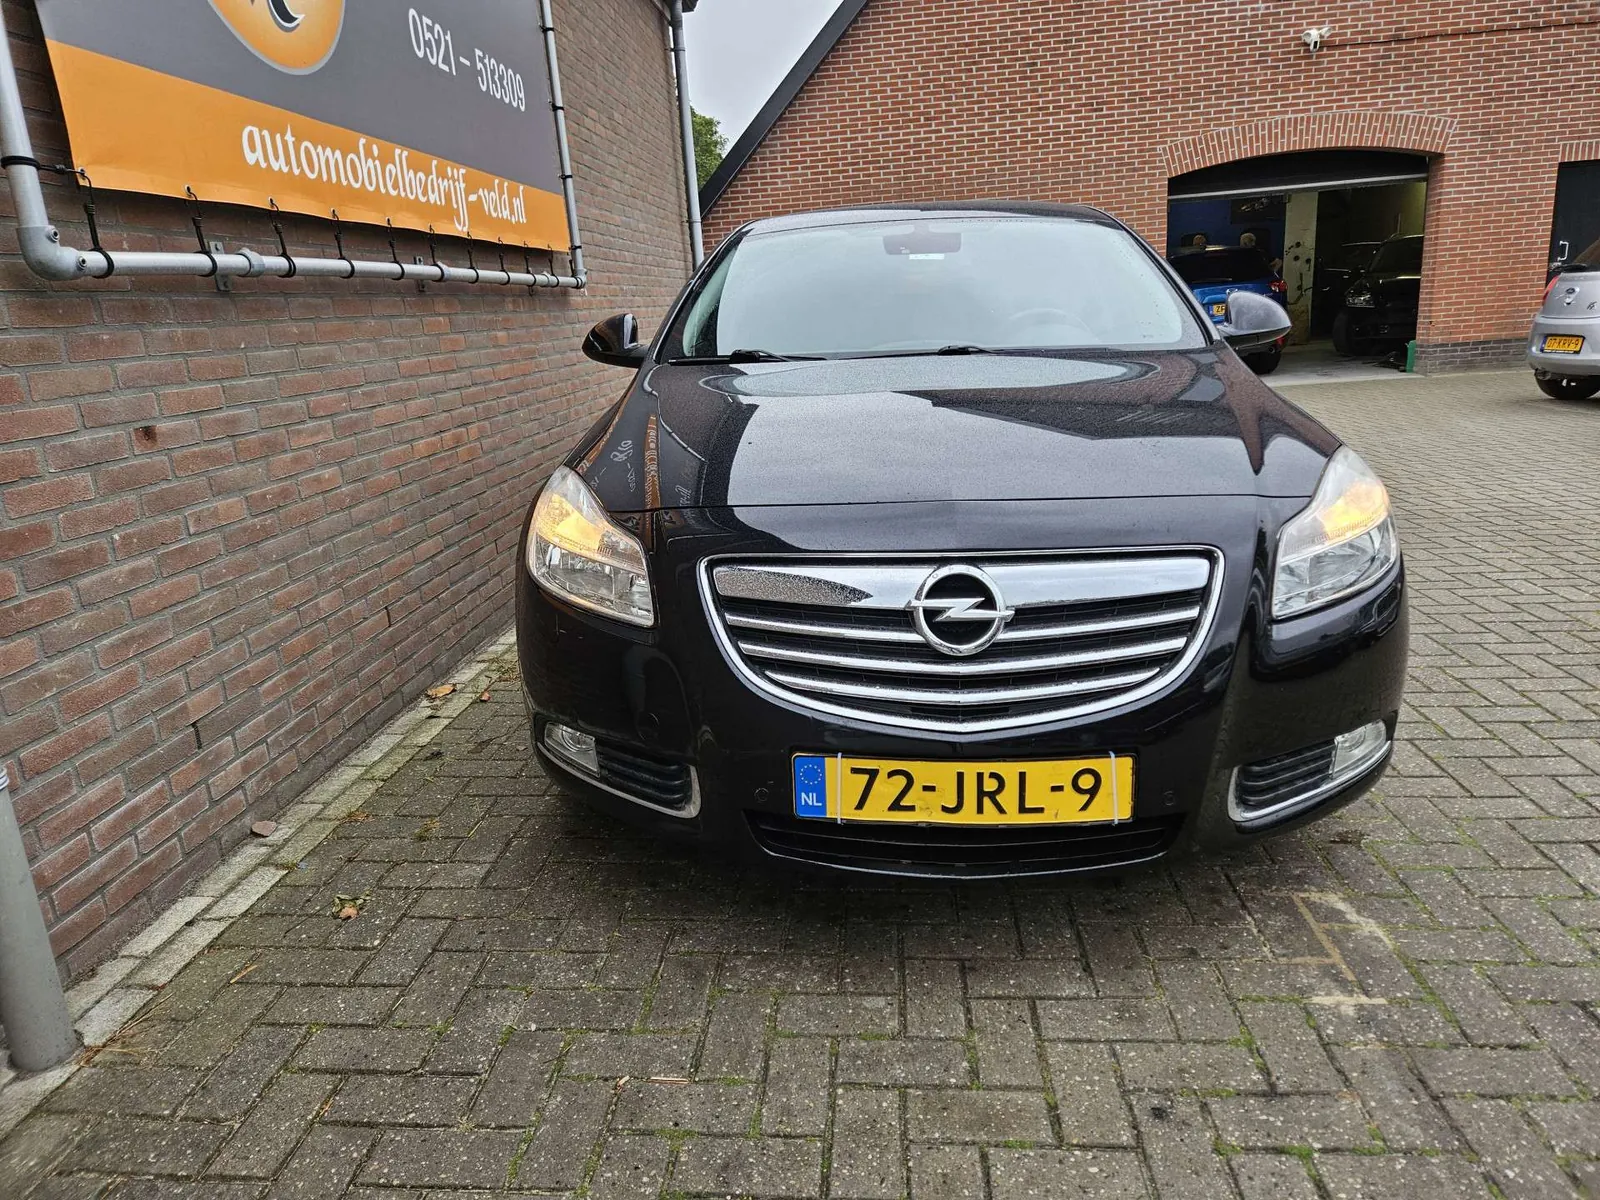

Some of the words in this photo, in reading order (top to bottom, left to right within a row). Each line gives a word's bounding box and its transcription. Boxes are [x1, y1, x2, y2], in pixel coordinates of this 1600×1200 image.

[408, 8, 456, 76] 0521
[474, 48, 526, 112] 513309
[241, 124, 527, 232] automobielbedrijf-veld.nl
[801, 792, 823, 806] NL
[850, 767, 1102, 815] 72-JRL-9
